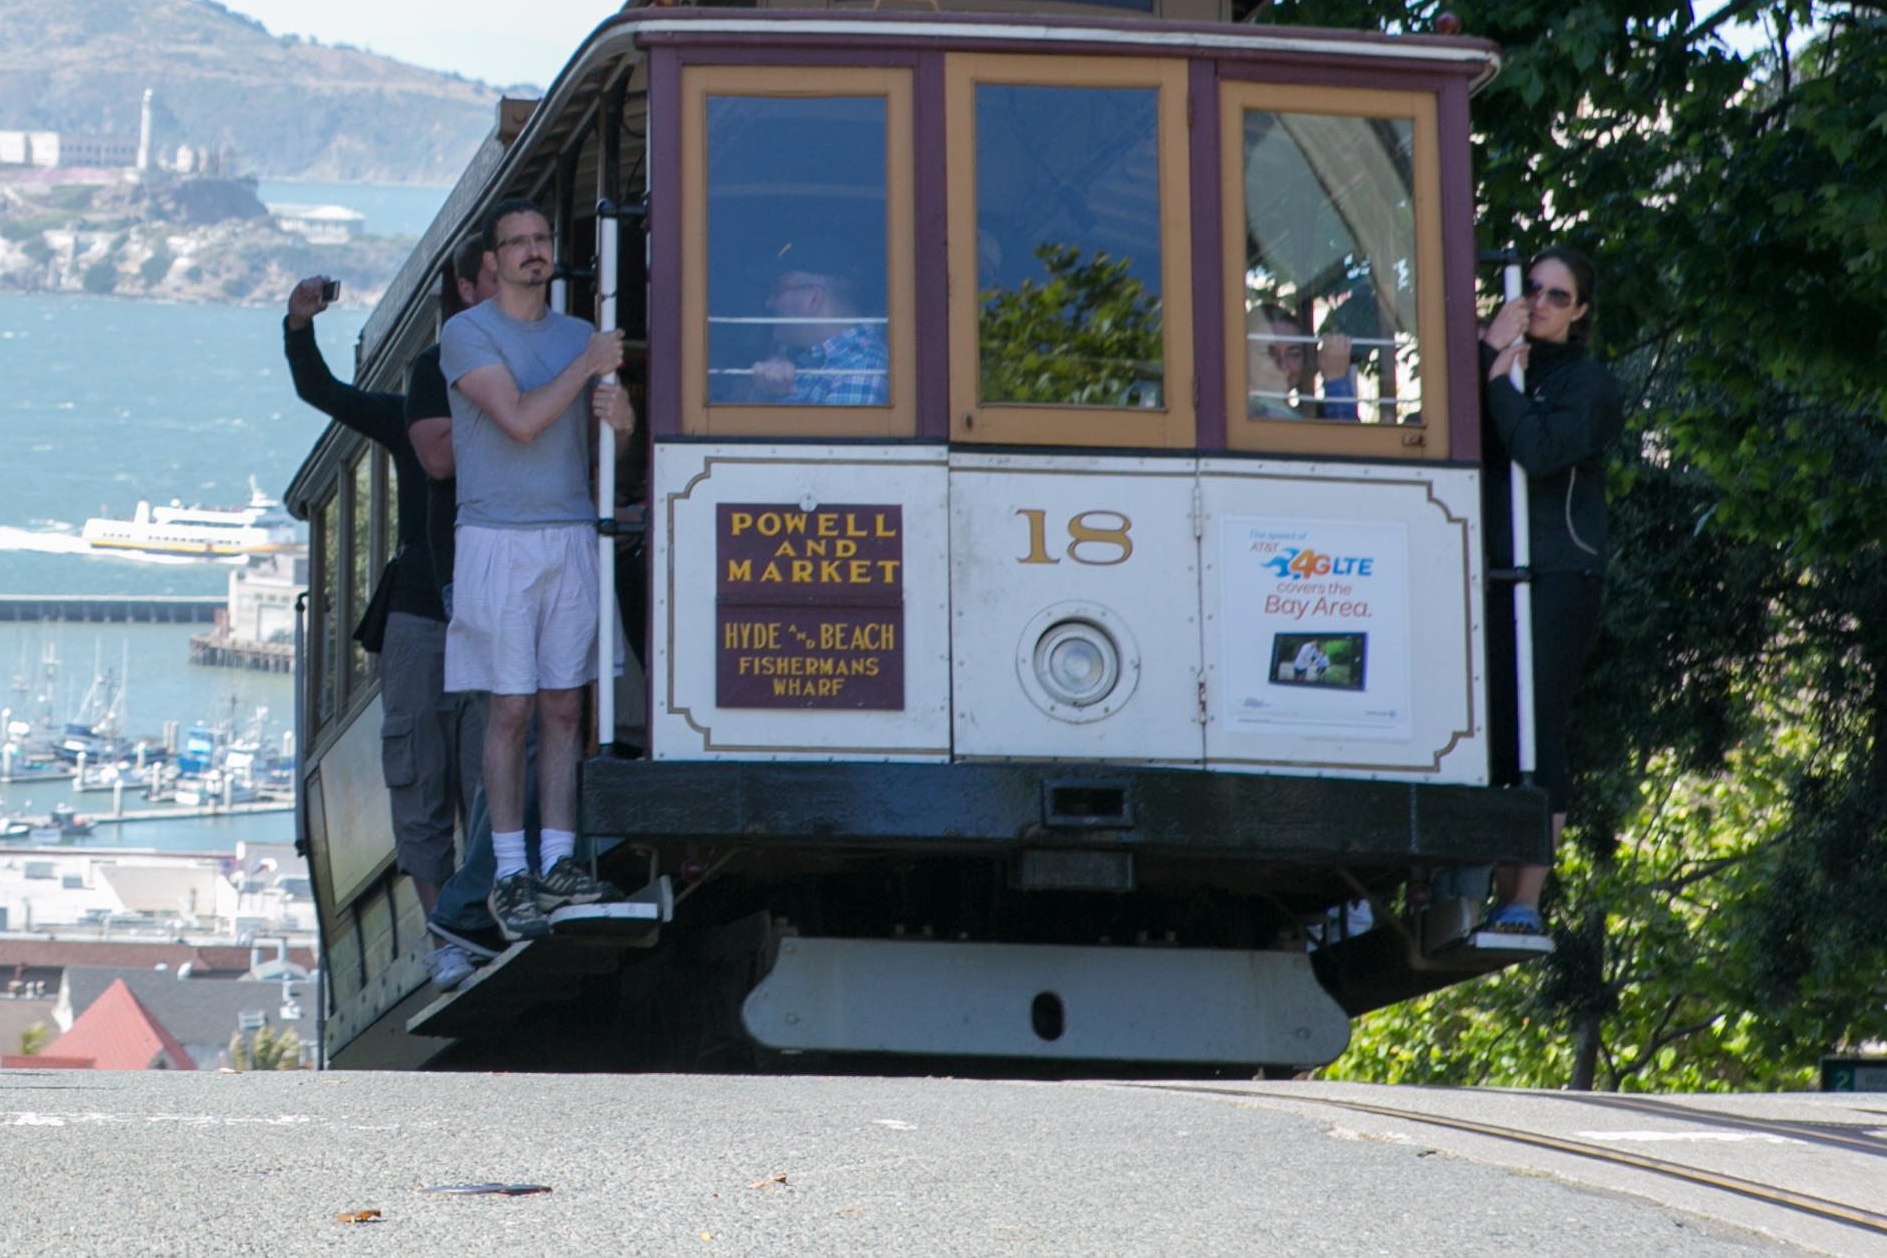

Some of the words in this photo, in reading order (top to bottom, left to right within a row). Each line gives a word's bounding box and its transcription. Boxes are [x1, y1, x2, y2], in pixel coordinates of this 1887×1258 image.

[730, 512, 897, 537] POWELL
[1014, 508, 1133, 566] 18
[1249, 542, 1280, 553] AT&T
[774, 539, 857, 558] AND
[727, 559, 900, 583] MARKET
[1276, 583, 1326, 594] covers
[1328, 582, 1352, 596] the
[1264, 594, 1310, 620] Bay
[1311, 597, 1372, 618] Area.
[724, 622, 781, 650] HYDE
[788, 624, 815, 650] AND
[820, 623, 895, 651] BEACH
[738, 657, 880, 676] FISHERMANS
[772, 678, 845, 696] WHARF
